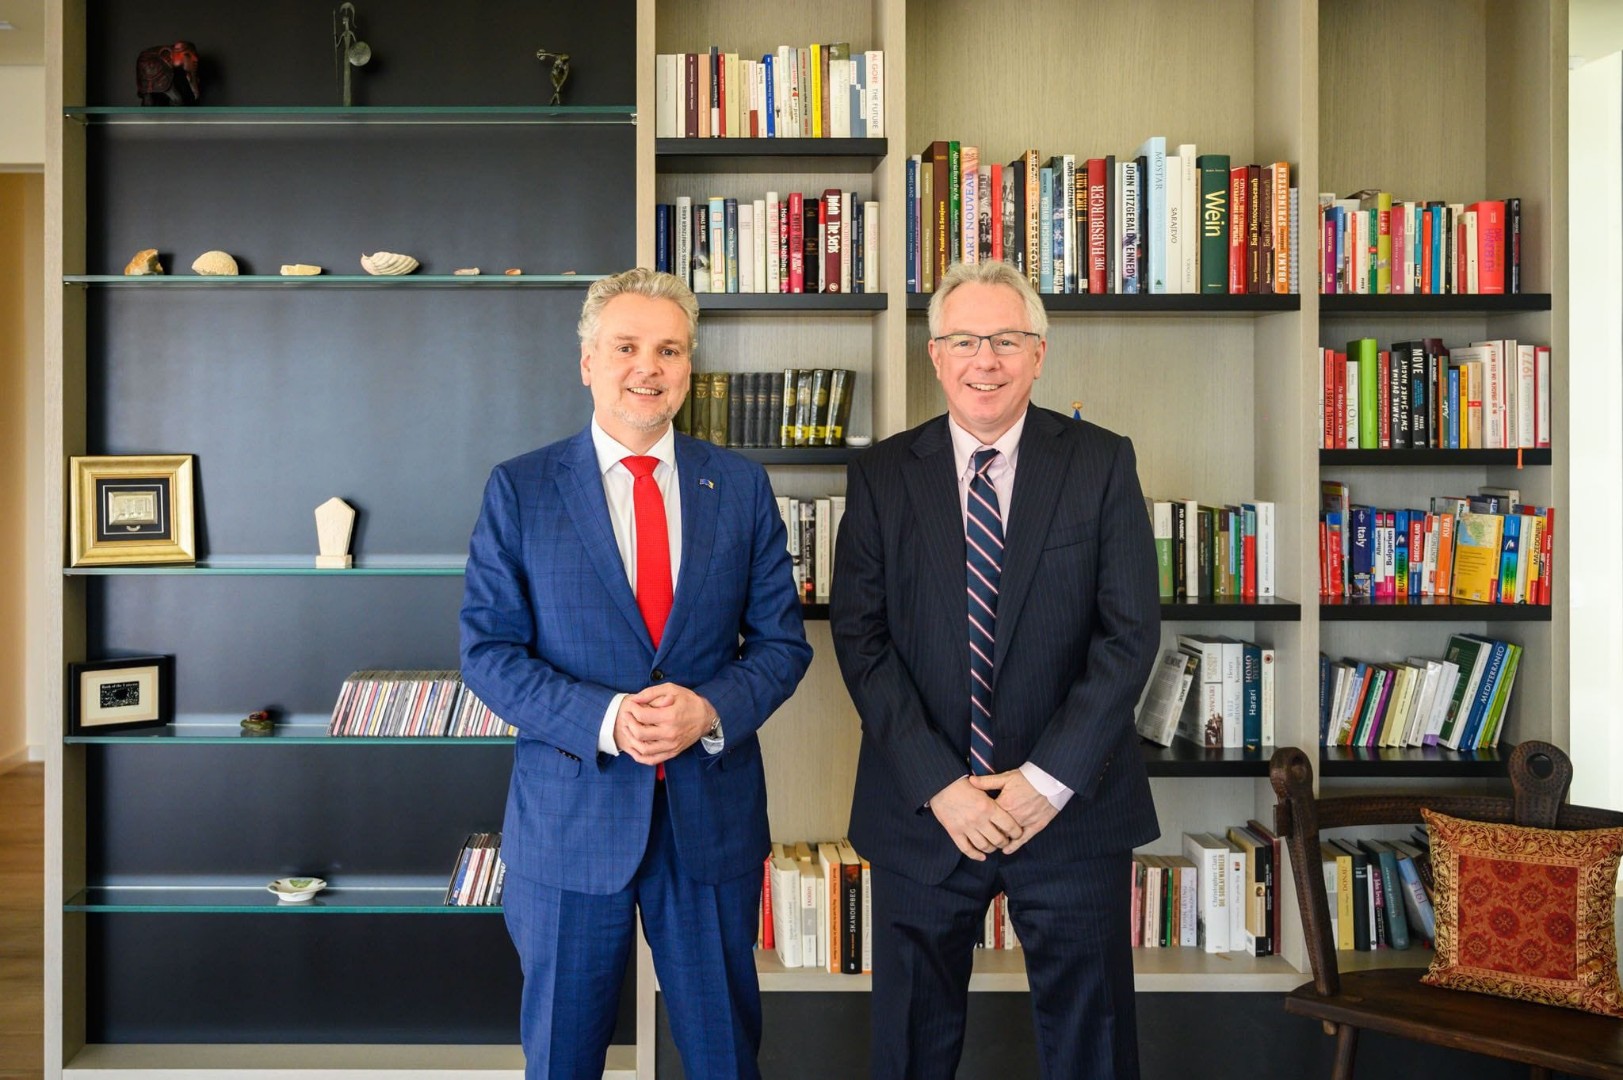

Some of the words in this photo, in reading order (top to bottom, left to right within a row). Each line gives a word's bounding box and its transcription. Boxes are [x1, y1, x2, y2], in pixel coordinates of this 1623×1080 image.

[872, 54, 878, 62] AL
[1126, 164, 1135, 186] JOHN
[1155, 151, 1163, 190] MOSTAR
[826, 194, 840, 215] Judah
[966, 172, 974, 230] NOUVEAU
[1278, 167, 1286, 226] SPRINGSTEEN
[827, 221, 840, 234] The
[1091, 184, 1105, 255] HABSBURGER
[1126, 190, 1135, 238] FITZGERALD
[1205, 190, 1226, 237] Wein
[827, 235, 840, 253] Serbs
[1094, 257, 1105, 270] DIE
[1126, 241, 1135, 279] KENNEDY
[1278, 252, 1286, 283] OBAMA
[1413, 348, 1423, 374] MOVE
[1522, 351, 1532, 380] 1977
[1356, 526, 1367, 547] Italy
[1442, 517, 1450, 538] KUBA
[1533, 520, 1542, 565] MAZEDONIEN
[1481, 646, 1504, 704] MEDITERRANEO
[1410, 880, 1427, 904] 1913
